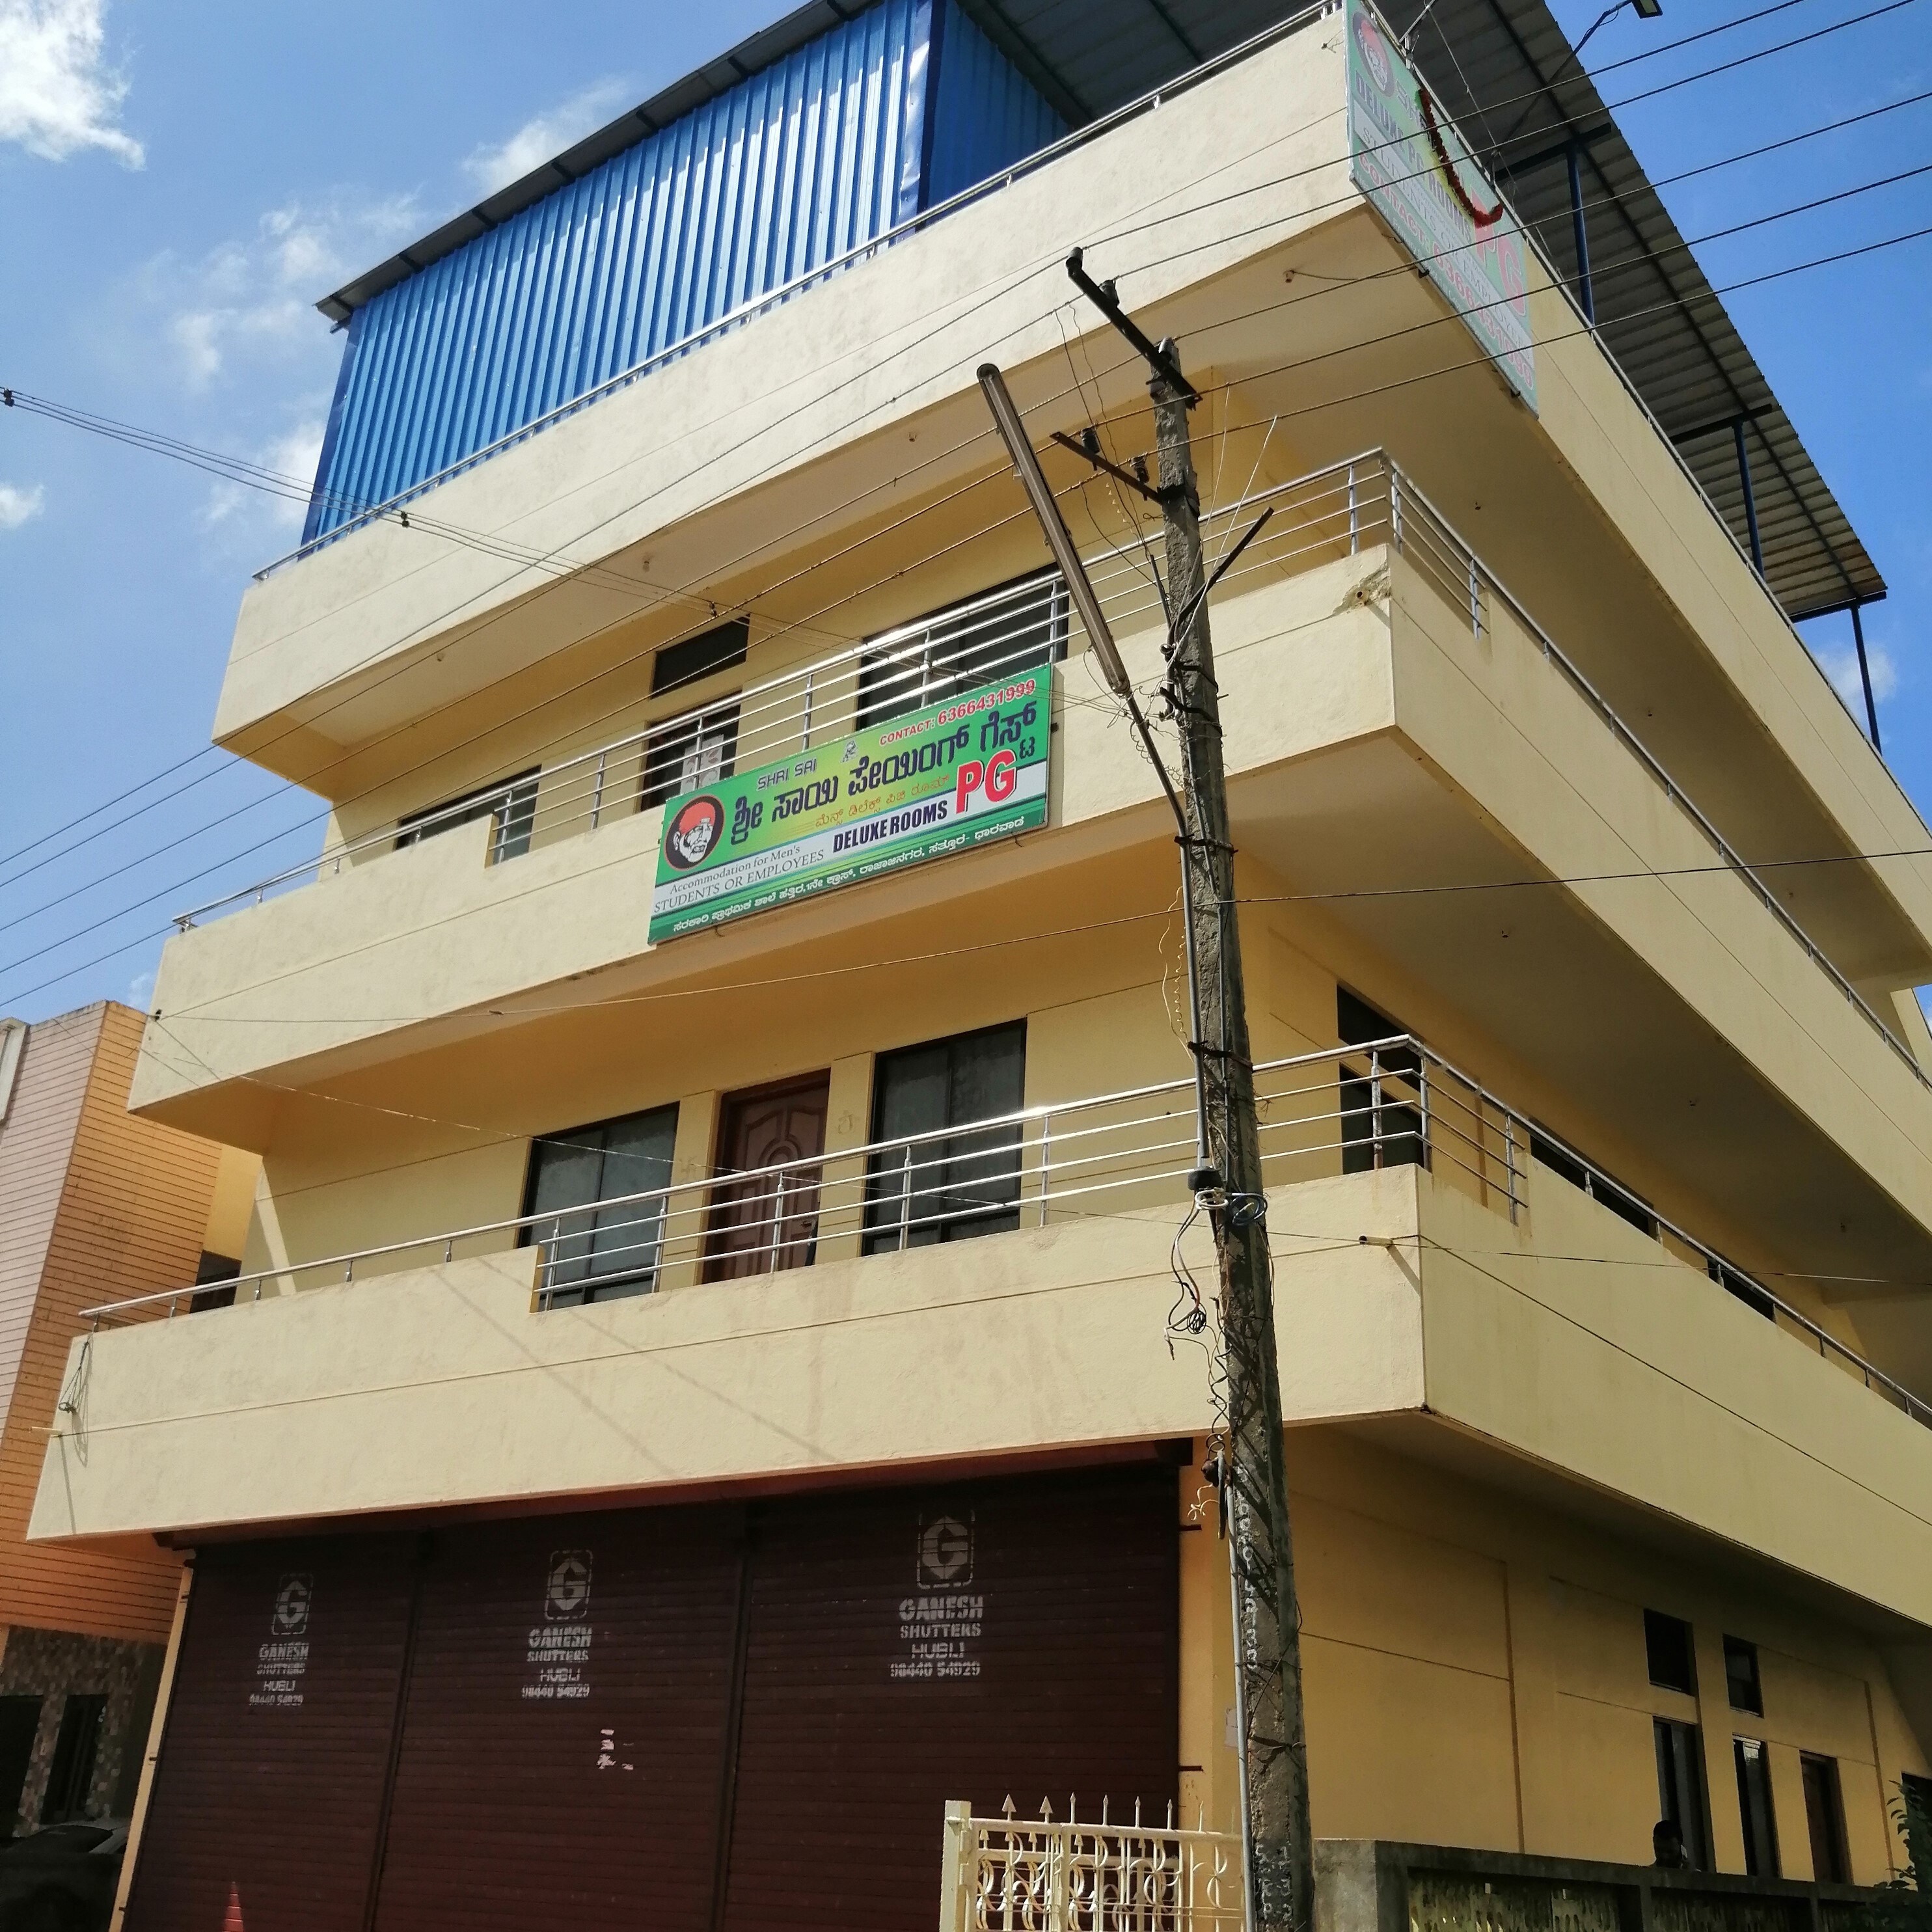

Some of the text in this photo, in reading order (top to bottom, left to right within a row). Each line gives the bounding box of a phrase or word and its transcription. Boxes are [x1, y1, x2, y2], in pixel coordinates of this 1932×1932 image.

[1355, 70, 1406, 154] DELUXE
[1408, 139, 1425, 180] PG
[1428, 170, 1471, 244] ROOMS
[1363, 127, 1436, 230] STUDENTS
[1432, 242, 1532, 390] 6366431999
[880, 679, 1035, 746] CONTACT: 6366431999
[731, 701, 1037, 845] ಶ್ರೀ ಸಾಯಿ ಪೇಯಿಂಗ್ ಗೆಸ್ಟ್
[757, 759, 817, 790] SHRI SAI
[956, 749, 1016, 813] PG
[832, 800, 947, 853] DELUXE ROOMS
[655, 849, 824, 912] STUDENTS OR EMPLOYEES
[670, 845, 800, 894] Accommodation for Men's
[899, 1595, 983, 1621] GANESH
[528, 1627, 593, 1648] GANESH
[900, 1622, 982, 1639] SHUTTERS
[259, 1641, 309, 1661] GANESH
[527, 1650, 590, 1663] SHUTTERS
[911, 1641, 965, 1659] HUBLI
[256, 1663, 306, 1675] SHUTTERS
[539, 1667, 580, 1682] HUBLI
[263, 1680, 295, 1692] HUBLI
